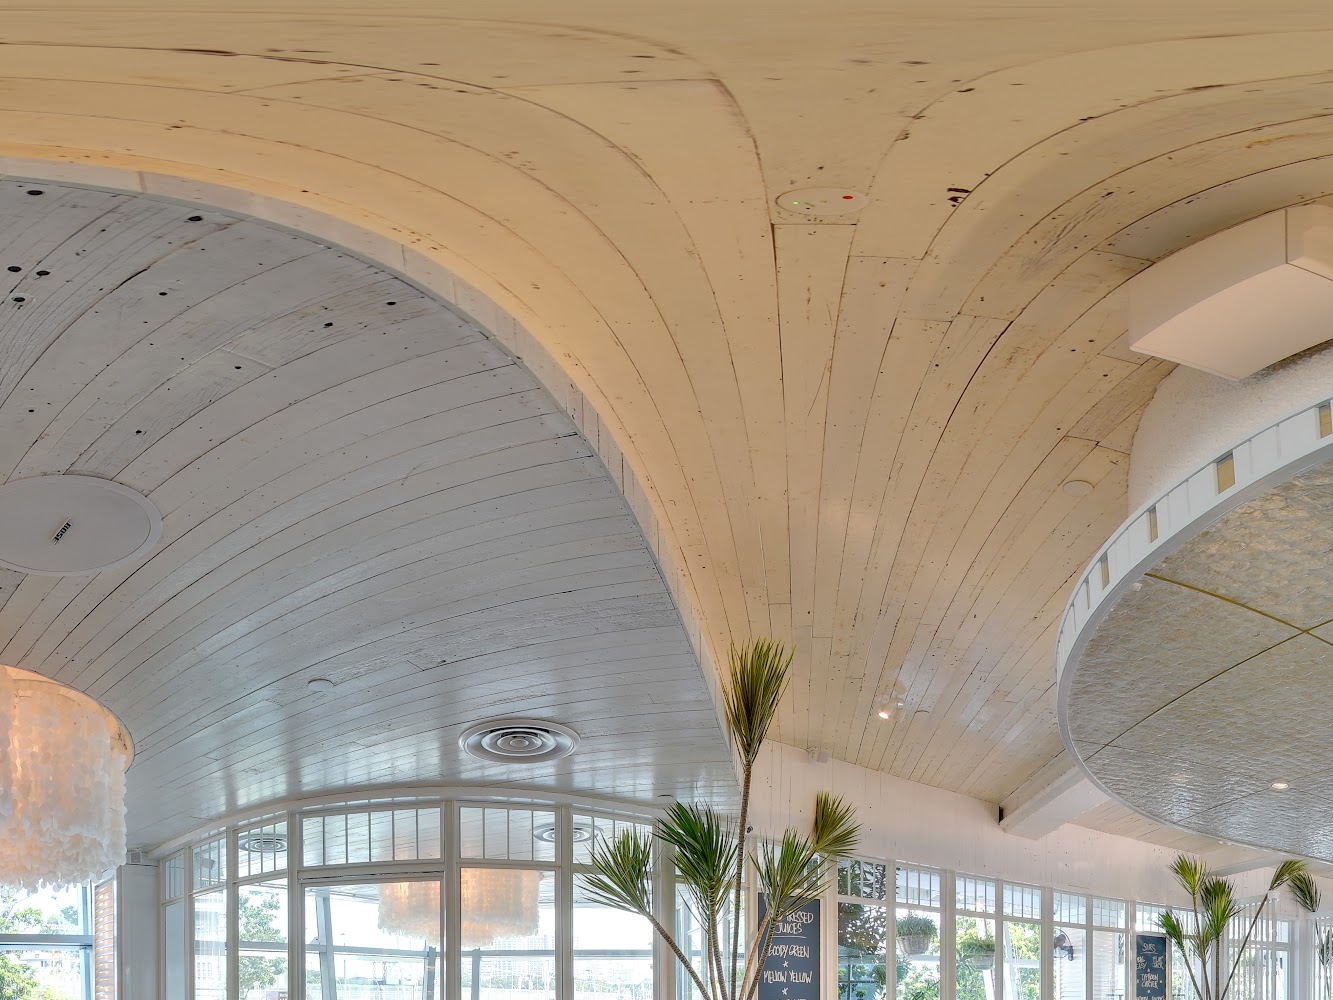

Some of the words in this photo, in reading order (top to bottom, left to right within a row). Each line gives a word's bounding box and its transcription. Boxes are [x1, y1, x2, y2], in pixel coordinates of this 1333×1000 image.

[788, 944, 809, 958] GREEN
[763, 970, 787, 983] MELLOW
[789, 970, 812, 983] YELLOW
